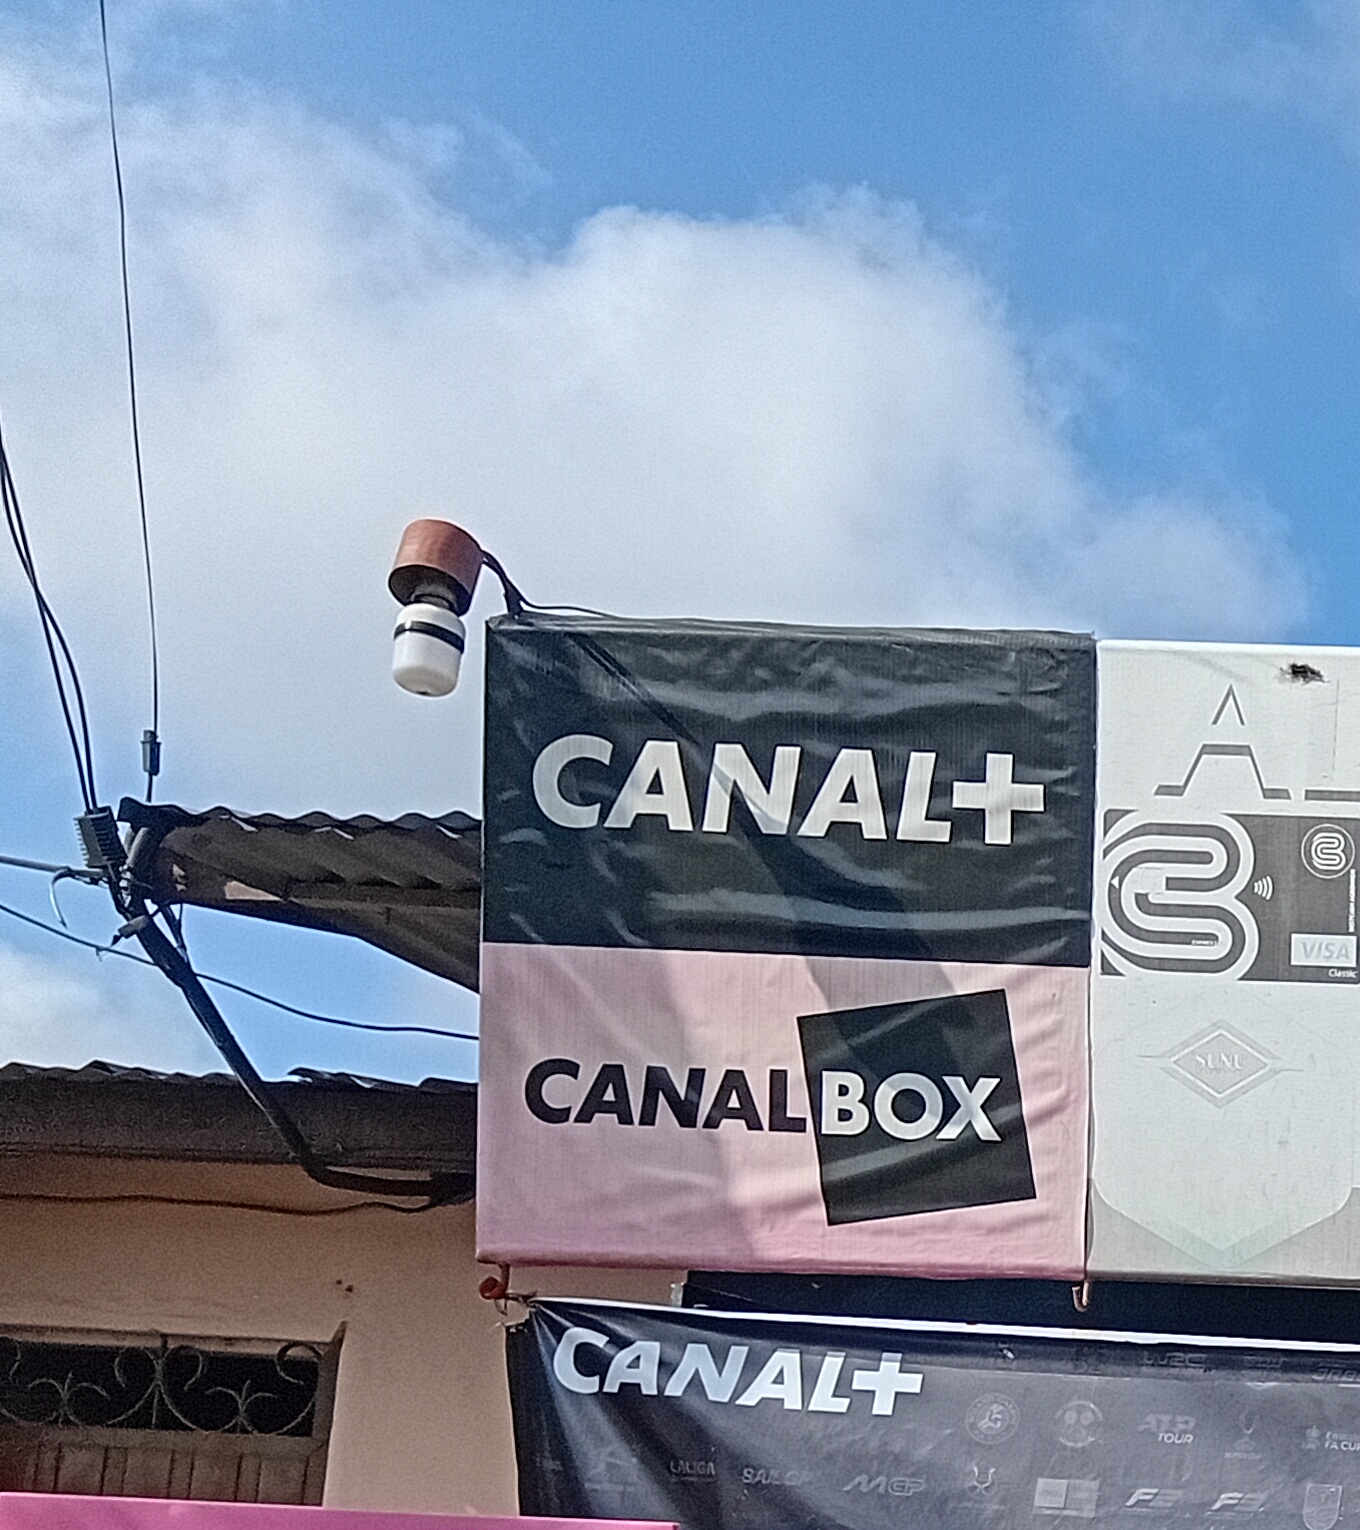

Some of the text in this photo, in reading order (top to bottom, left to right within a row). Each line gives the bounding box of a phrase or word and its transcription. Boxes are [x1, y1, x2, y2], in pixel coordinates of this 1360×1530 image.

[531, 734, 1046, 846] CANAL+
[1301, 942, 1351, 961] VISA
[552, 1325, 924, 1417] CANAL+
